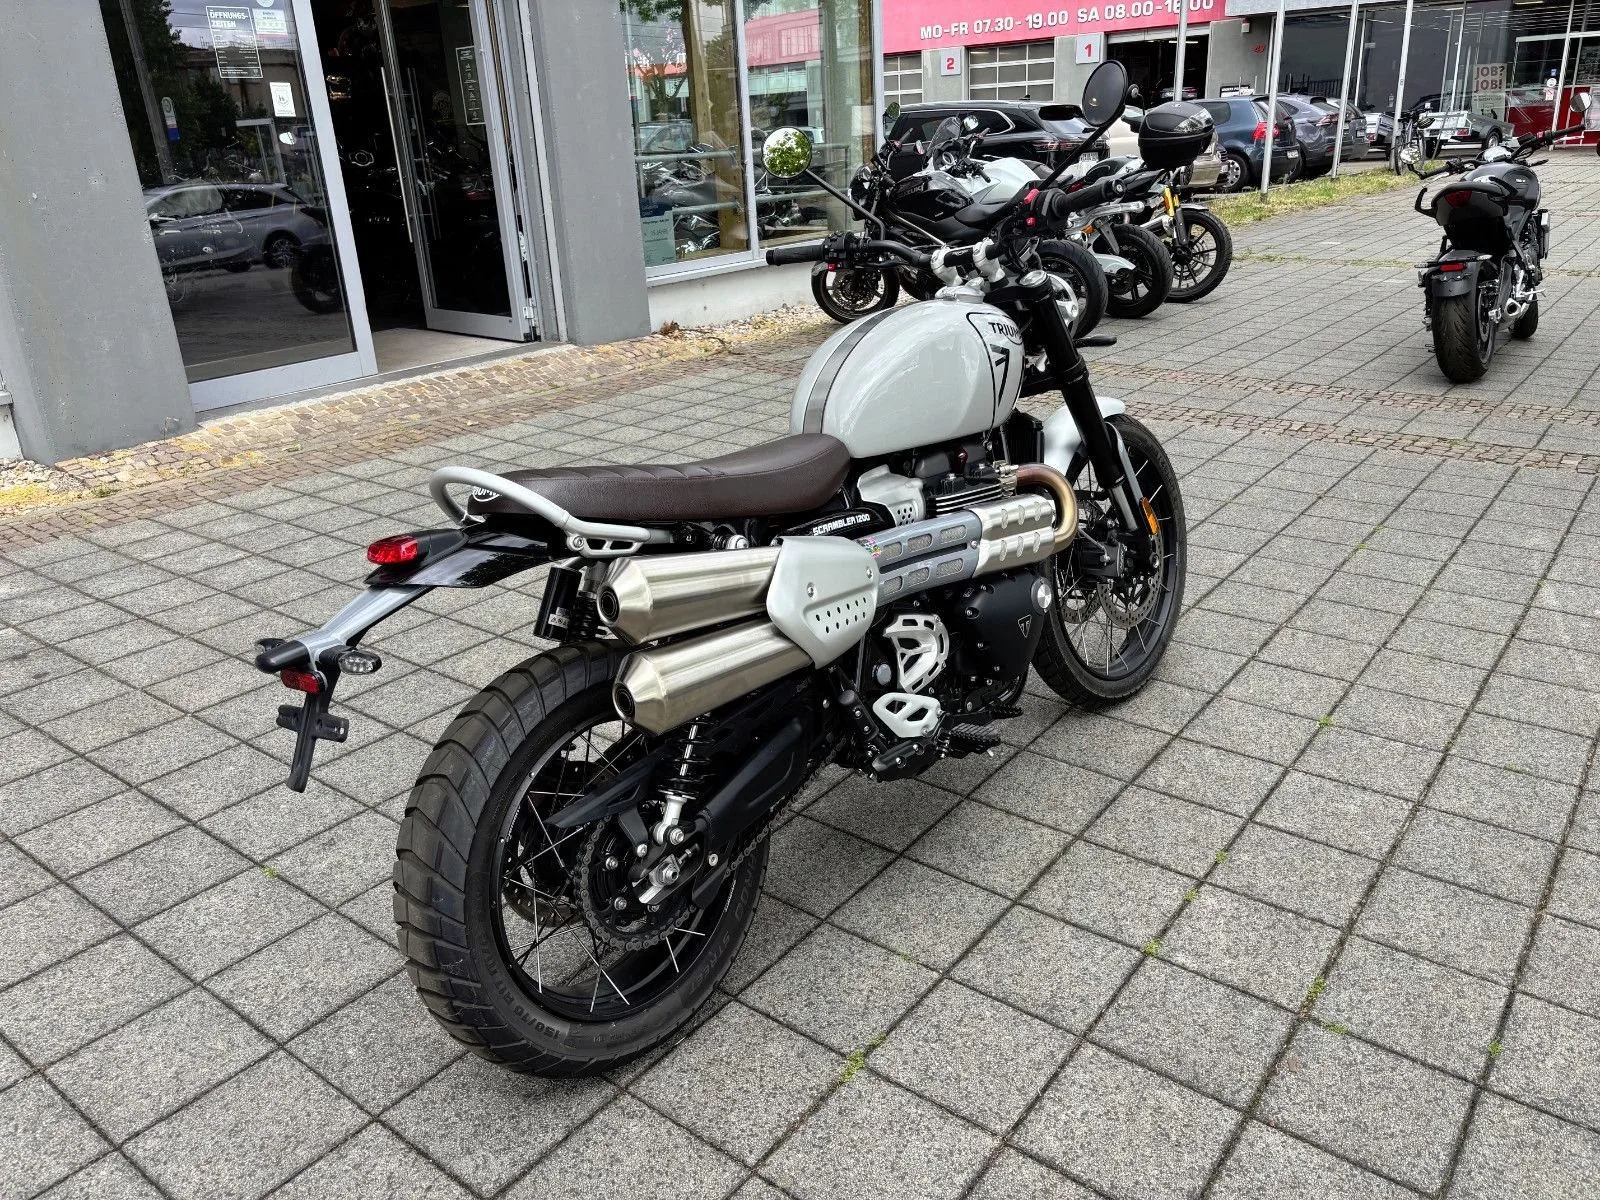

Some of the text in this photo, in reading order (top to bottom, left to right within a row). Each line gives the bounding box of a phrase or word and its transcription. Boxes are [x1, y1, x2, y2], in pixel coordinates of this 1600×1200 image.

[209, 9, 249, 20] ÖFFNUNGS-
[211, 20, 237, 28] ZEITEN
[920, 22, 969, 40] MO-FR
[1077, 10, 1100, 23] SA
[1084, 43, 1092, 57] 1
[946, 57, 955, 70] 2
[1475, 65, 1505, 80] JOB?
[1475, 79, 1503, 92] JOB!
[812, 513, 871, 536] SCRAMBLER 1200
